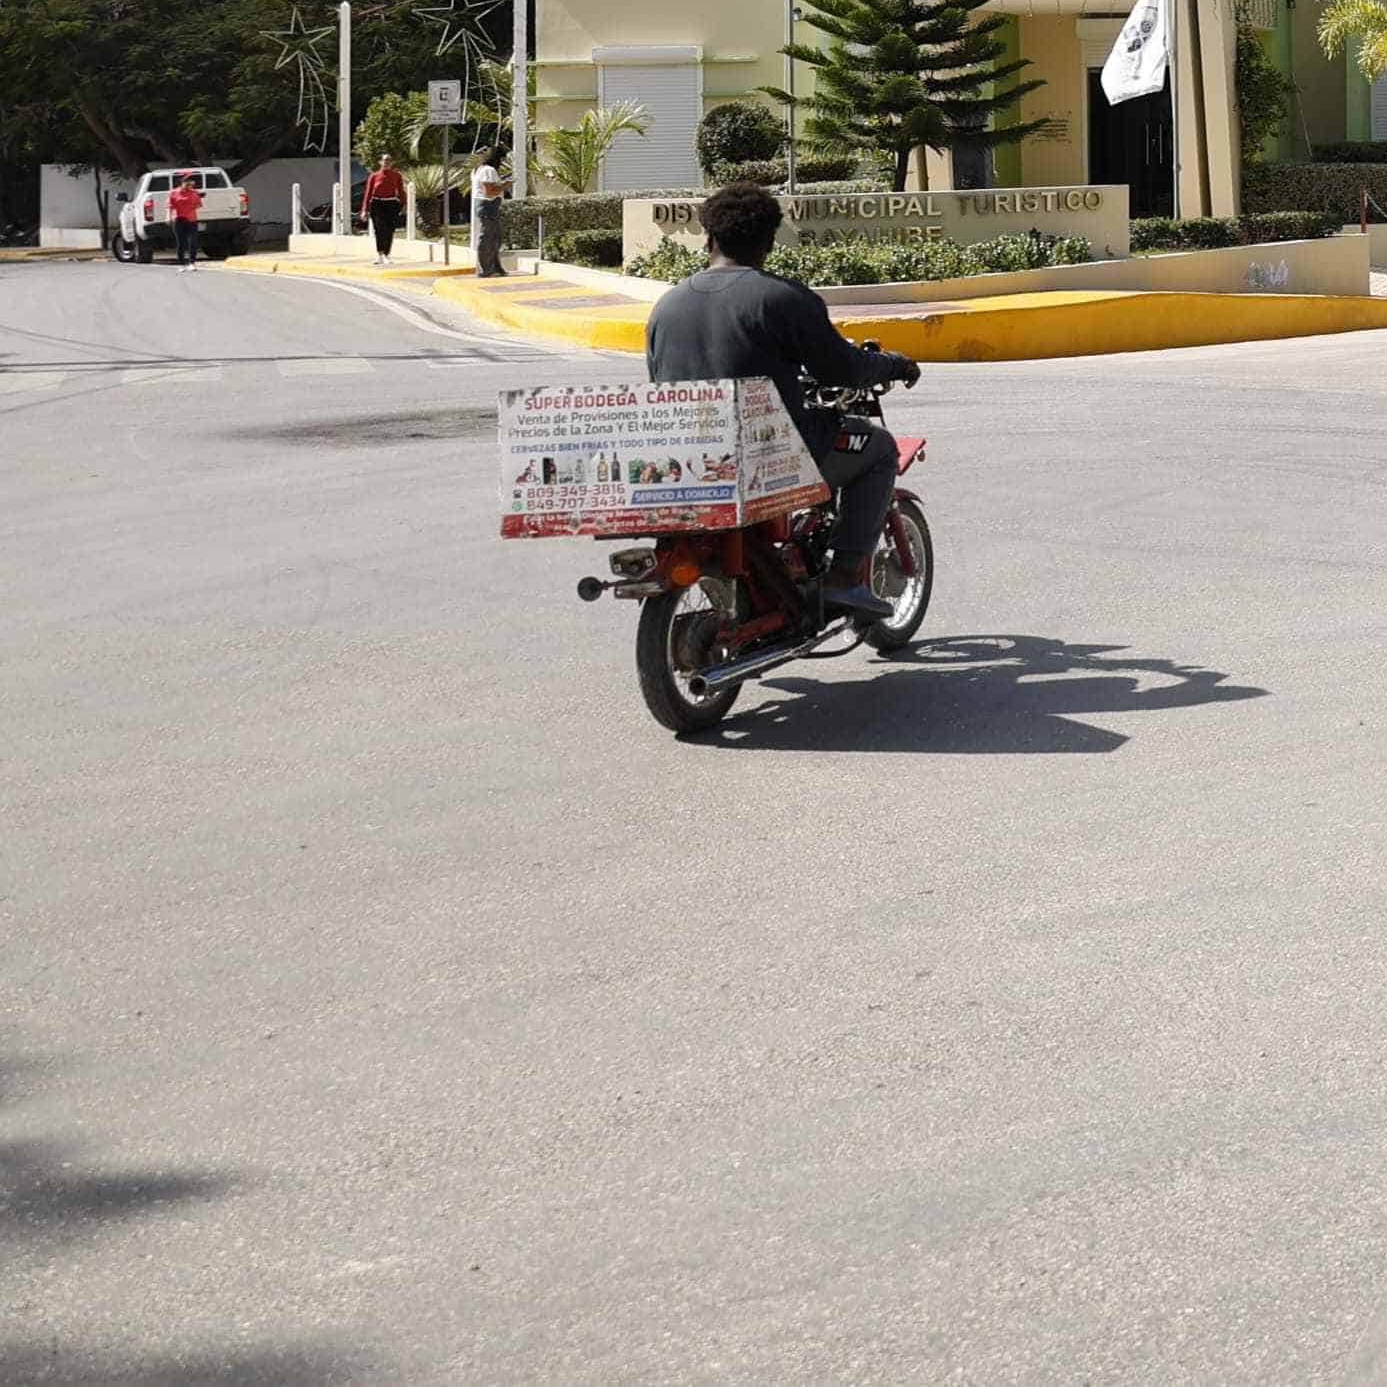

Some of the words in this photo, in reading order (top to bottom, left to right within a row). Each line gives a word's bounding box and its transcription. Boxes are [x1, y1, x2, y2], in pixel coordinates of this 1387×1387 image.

[789, 196, 943, 221] MUNICIPAL
[956, 191, 1102, 216] TURISTICO
[525, 395, 571, 411] SUPER
[574, 392, 637, 408] BODEGA
[646, 388, 724, 404] CAROLINA
[517, 413, 551, 425] Venta
[553, 412, 568, 424] de
[572, 410, 638, 423] Provisiones
[652, 408, 670, 419] los
[508, 427, 551, 438] Precios
[552, 425, 568, 436] de
[571, 424, 581, 435] la
[583, 423, 614, 435] Zona
[643, 419, 674, 433] Mejor
[646, 437, 668, 447] TIPO
[527, 485, 625, 498] 809-349-3816
[634, 490, 675, 504] SERVICIO
